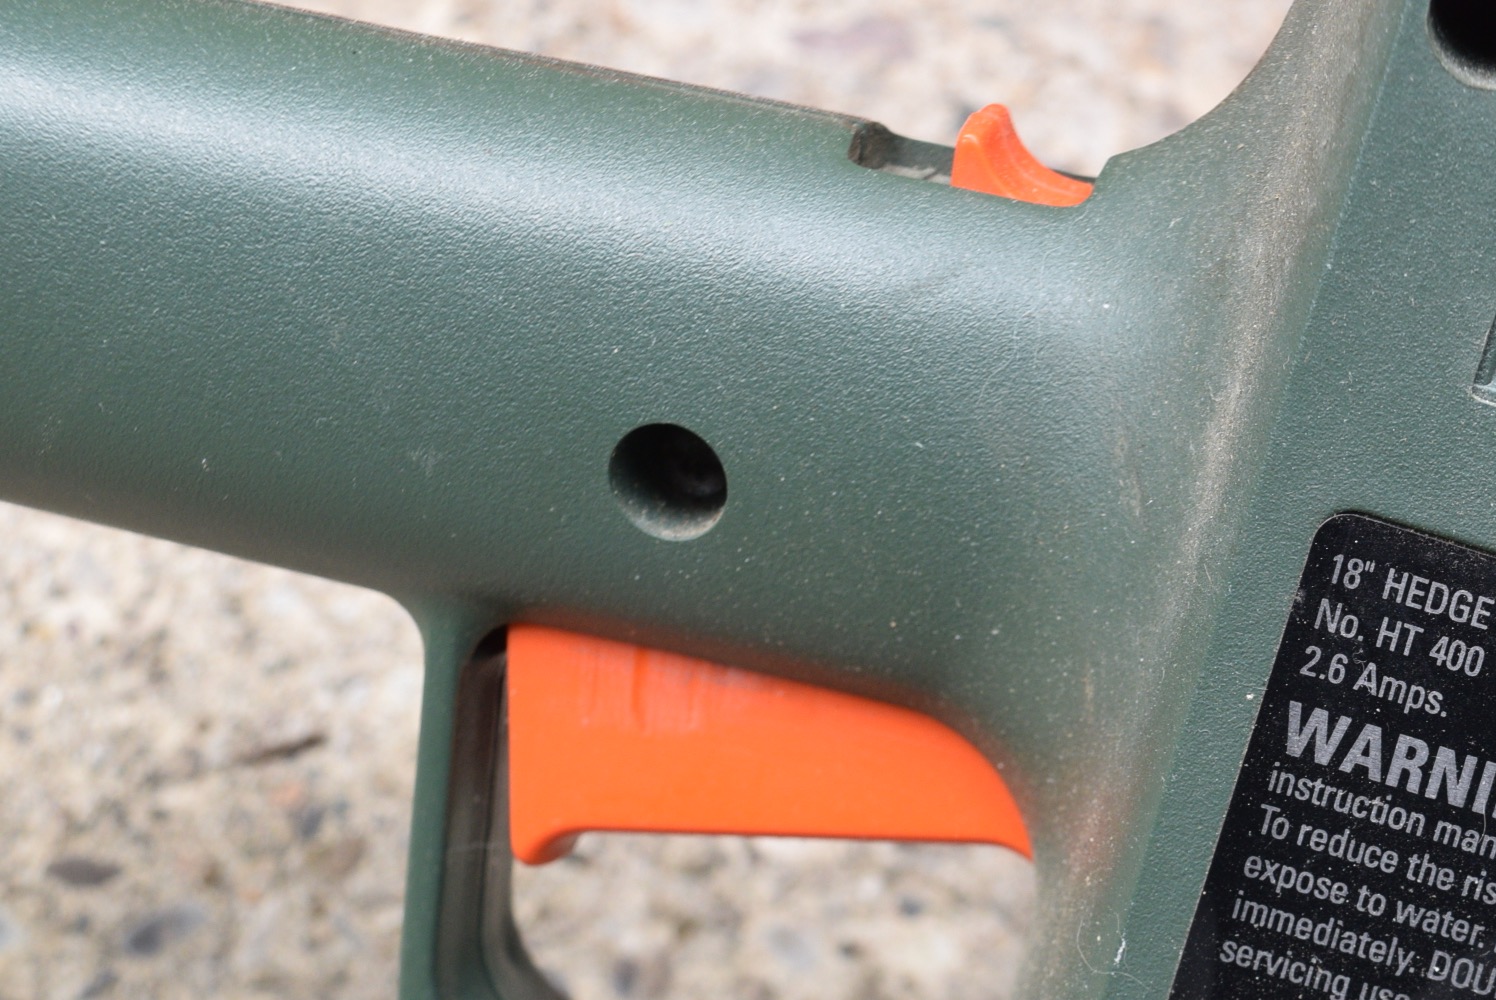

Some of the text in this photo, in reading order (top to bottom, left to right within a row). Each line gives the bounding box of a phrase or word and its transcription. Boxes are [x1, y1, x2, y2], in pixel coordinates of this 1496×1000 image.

[1332, 554, 1375, 590] 18"
[1382, 567, 1496, 630] HEDGE
[1314, 597, 1364, 642] No.
[1376, 617, 1424, 656] HT
[1429, 636, 1485, 677] 400
[1300, 645, 1347, 685] 2.6
[1353, 662, 1448, 718] Amps.
[1266, 762, 1427, 837] instruction
[1260, 803, 1290, 840] To
[1296, 823, 1398, 873] reduce
[1407, 852, 1455, 890] the
[1231, 890, 1416, 976] immediately.
[1243, 854, 1350, 904] expose
[1356, 885, 1387, 917] to
[1396, 901, 1485, 949] water.
